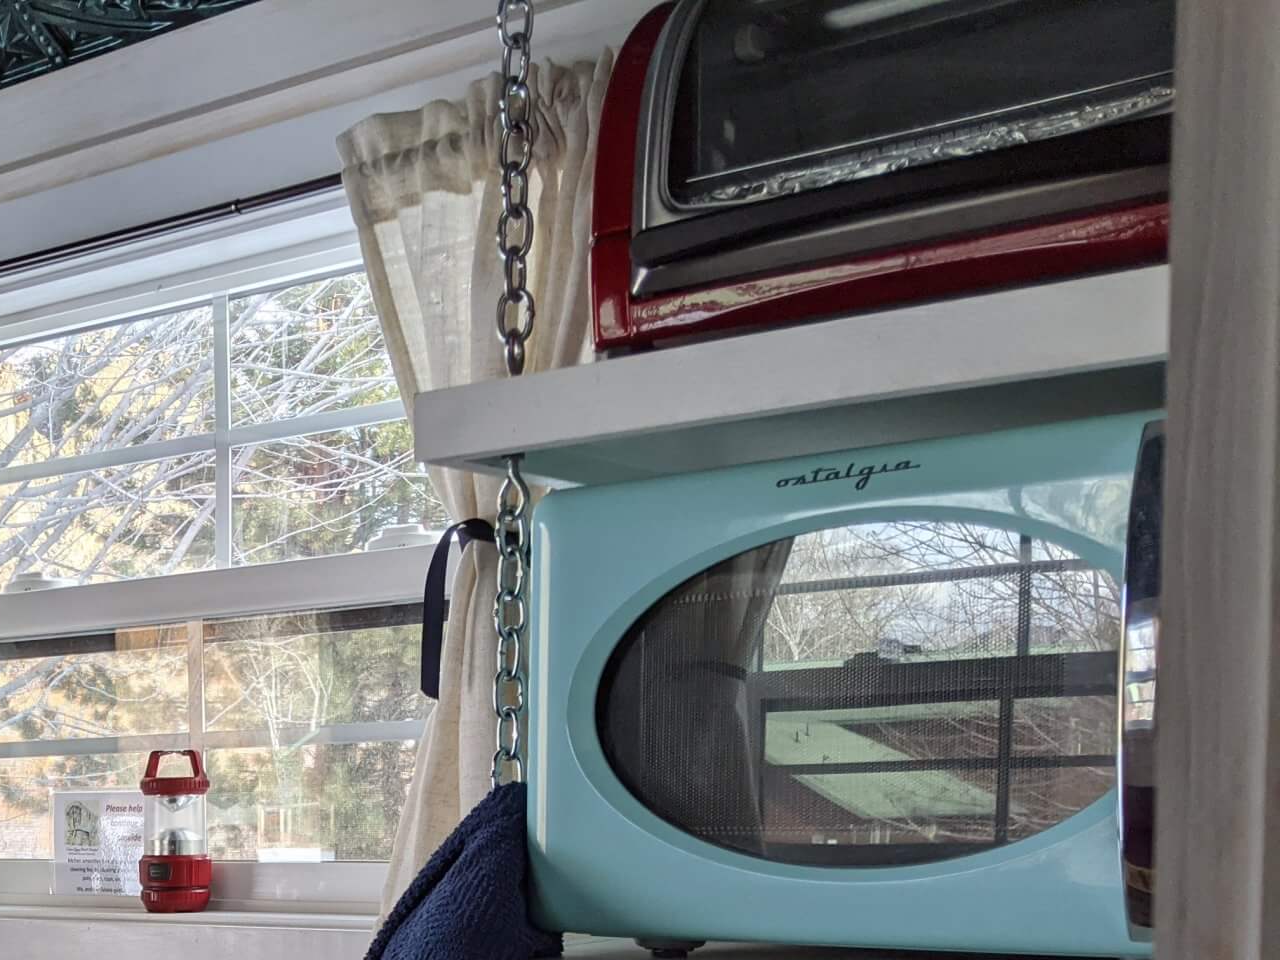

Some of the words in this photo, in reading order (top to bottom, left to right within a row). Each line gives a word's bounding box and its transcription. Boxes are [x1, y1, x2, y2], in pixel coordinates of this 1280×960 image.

[776, 460, 921, 490] ostalgia
[105, 804, 127, 813] Please
[128, 803, 143, 814] help
